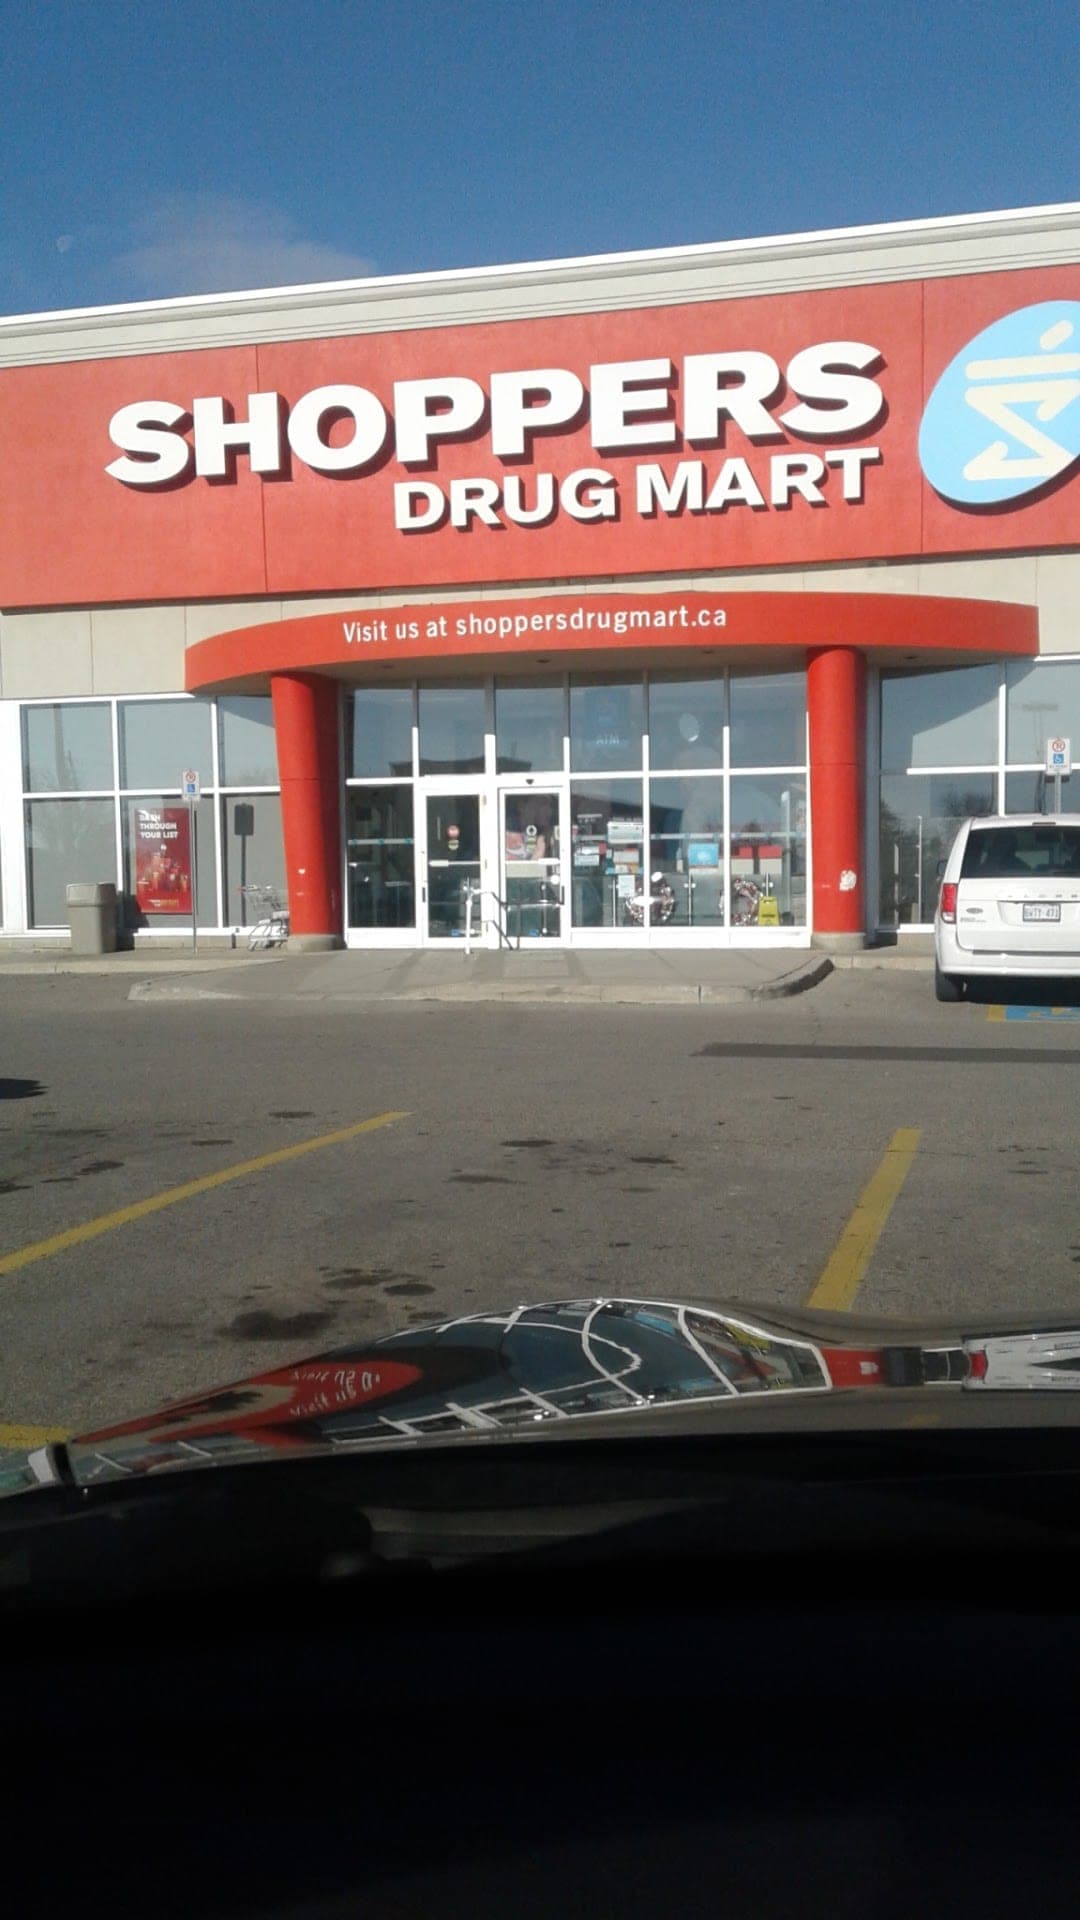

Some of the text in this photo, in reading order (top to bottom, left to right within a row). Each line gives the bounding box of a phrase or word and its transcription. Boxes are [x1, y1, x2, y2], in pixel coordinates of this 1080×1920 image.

[104, 341, 884, 483] SHOPPERS
[393, 446, 880, 529] DRUG MART
[342, 604, 728, 643] Visit us at shoppersdrugmart.ca
[140, 822, 178, 830] THROUGH
[140, 831, 178, 839] YOUR LIST
